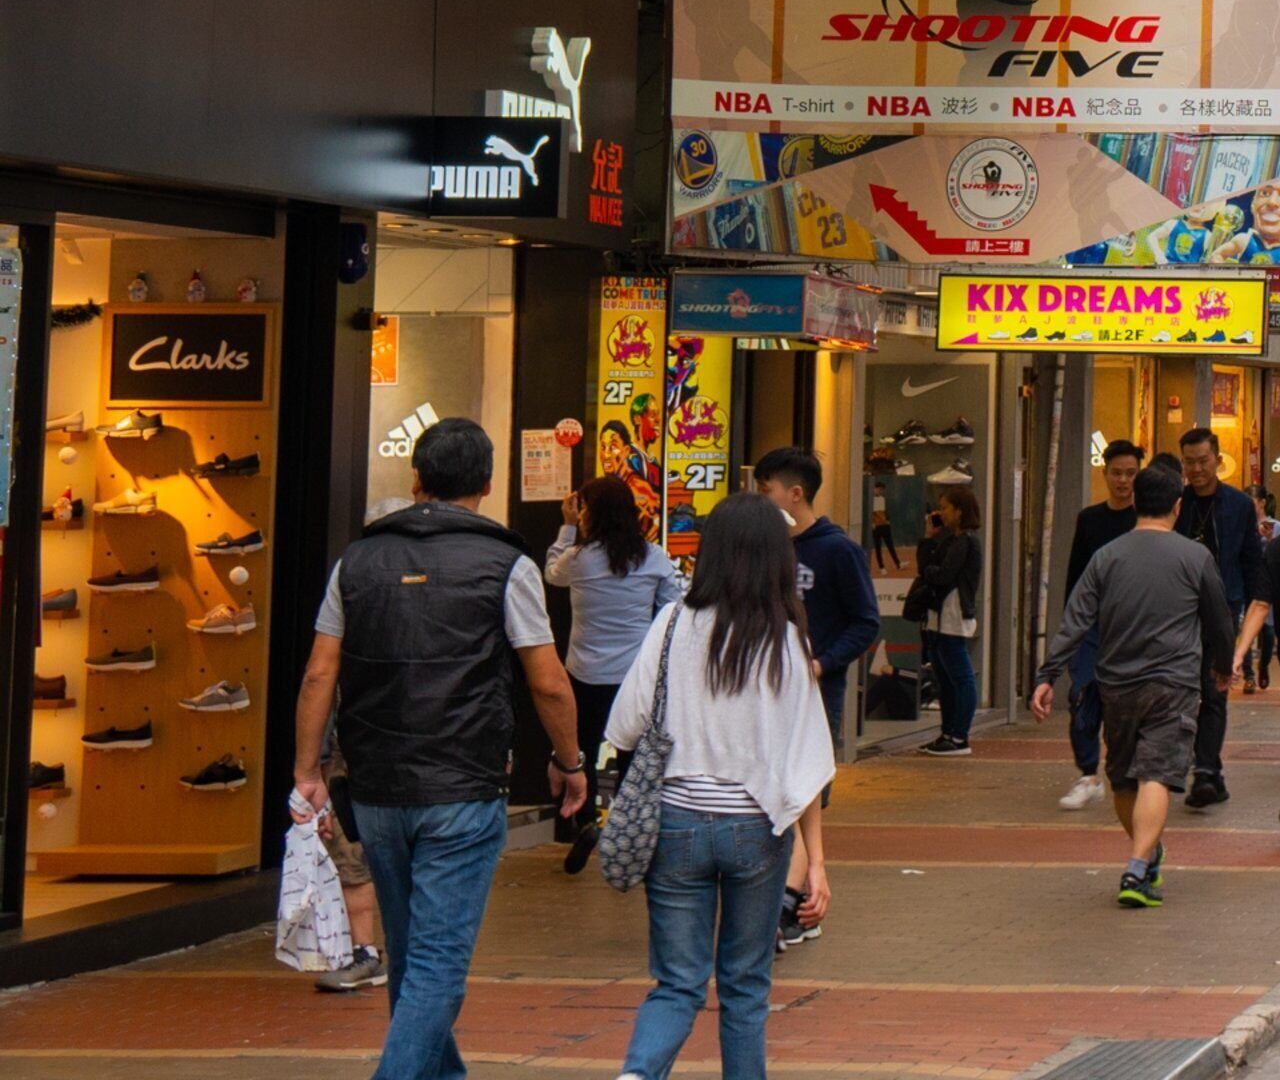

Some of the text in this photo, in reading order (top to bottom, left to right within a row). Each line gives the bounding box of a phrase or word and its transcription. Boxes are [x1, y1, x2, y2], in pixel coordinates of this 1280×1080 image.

[820, 13, 1162, 43] SHOOTING
[986, 50, 1164, 78] FIVE
[714, 91, 1272, 118] NBA T-shirt NBA 波衫 NBA 紀念品 各樣收藏品
[689, 138, 708, 157] 30
[431, 165, 520, 198] PUMA
[1221, 172, 1236, 192] 13
[817, 212, 847, 249] 23
[602, 276, 622, 287] KIX
[602, 287, 666, 300] COME TRUE
[967, 284, 1182, 314] KIX DREAMS
[1097, 329, 1144, 342] 請上2F
[128, 334, 251, 372] Clarks
[603, 380, 633, 404] 2F
[685, 464, 725, 490] 2F
